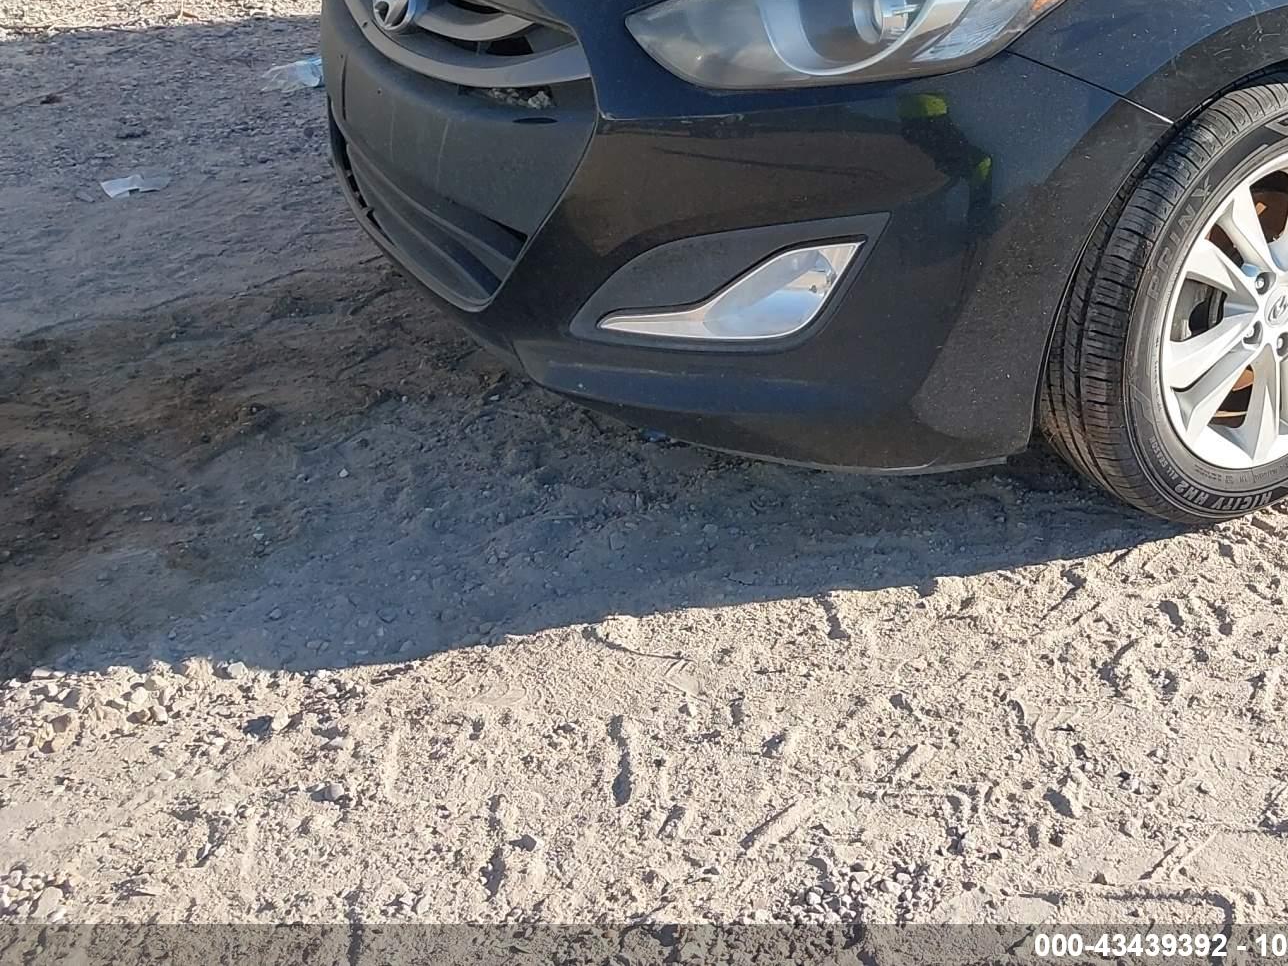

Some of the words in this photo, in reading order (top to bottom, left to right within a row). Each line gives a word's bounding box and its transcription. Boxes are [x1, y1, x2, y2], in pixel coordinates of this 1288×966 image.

[1149, 435, 1169, 468] SEASON
[1166, 465, 1179, 481] ALL
[1210, 490, 1273, 510] HICITY
